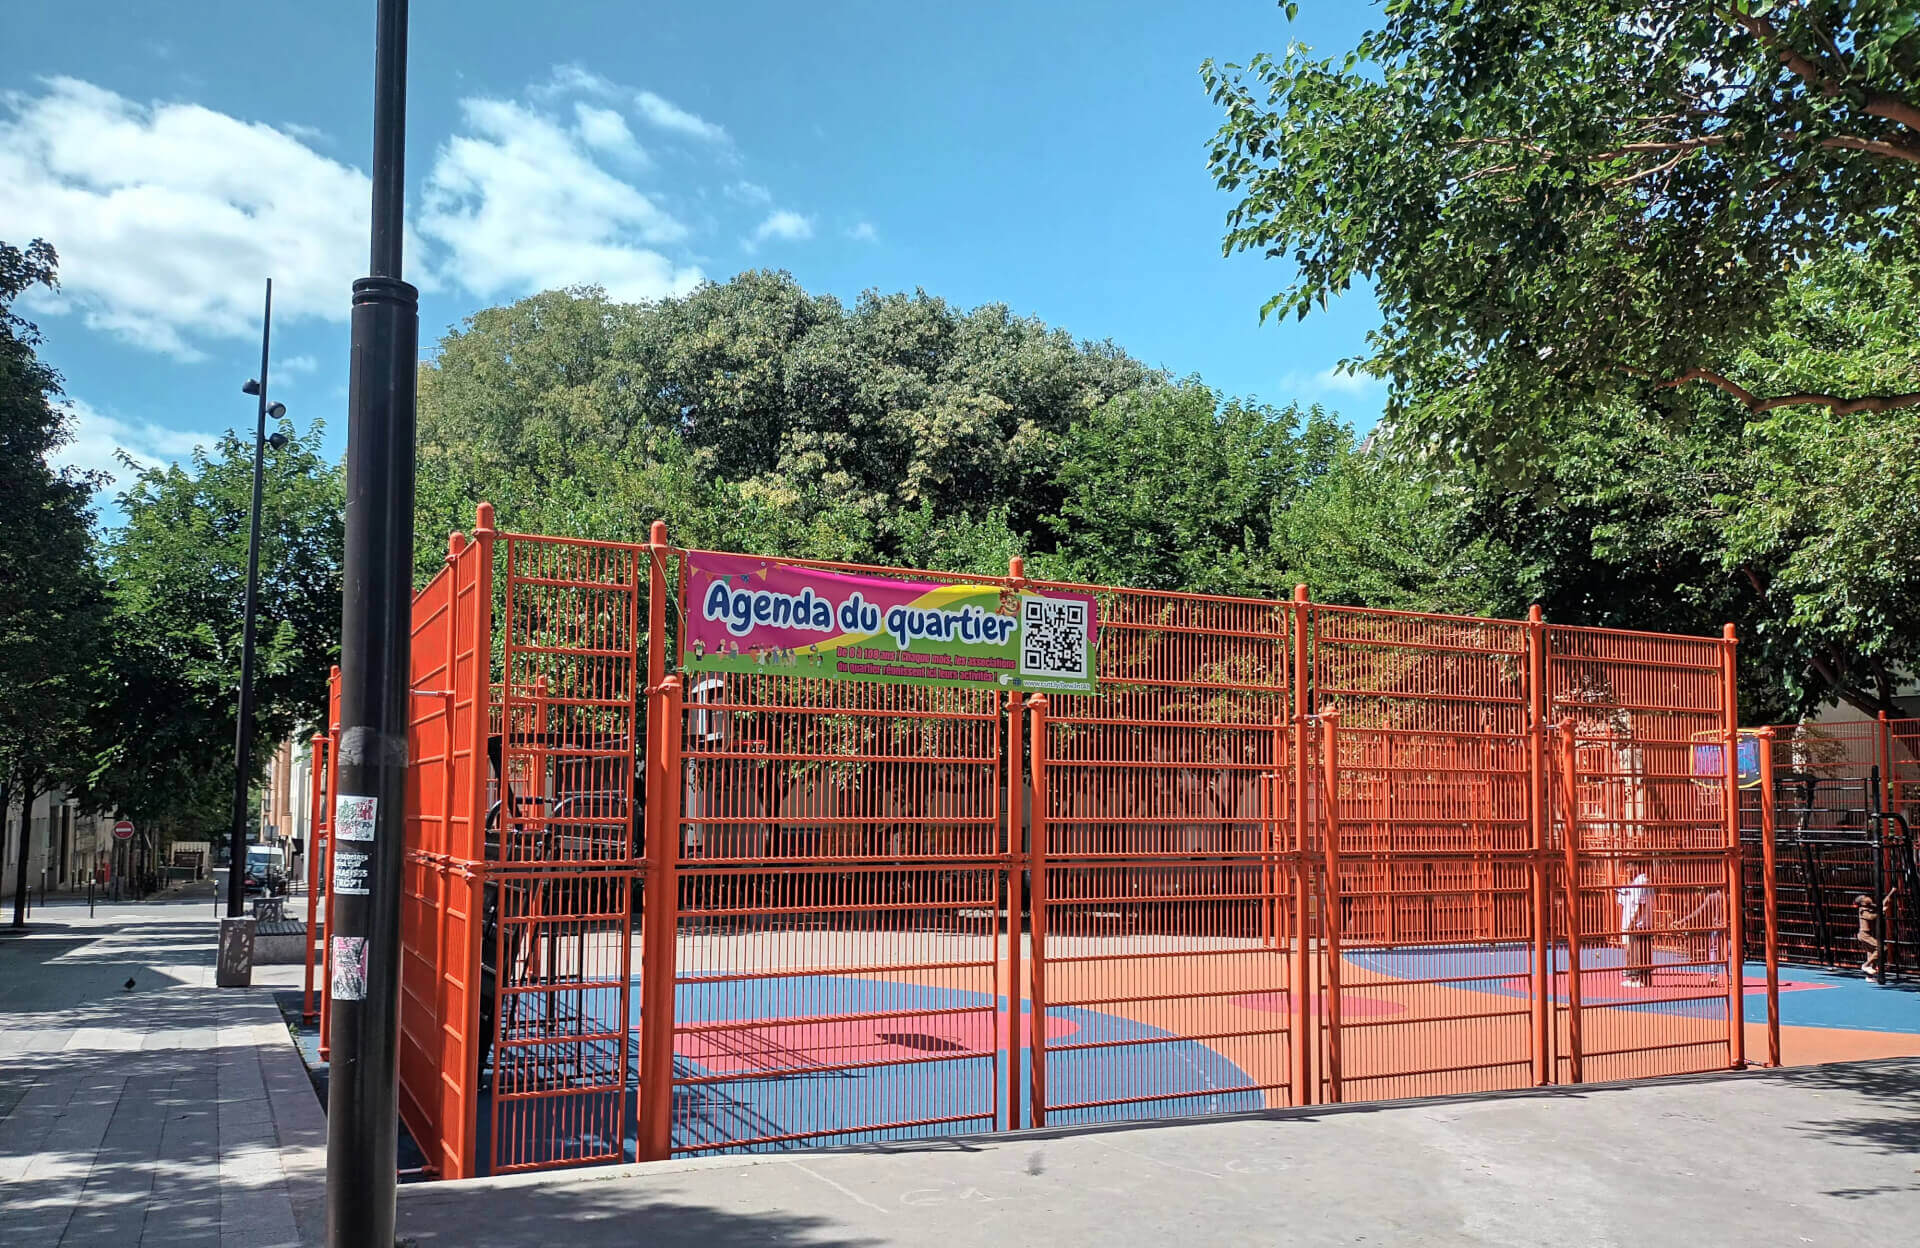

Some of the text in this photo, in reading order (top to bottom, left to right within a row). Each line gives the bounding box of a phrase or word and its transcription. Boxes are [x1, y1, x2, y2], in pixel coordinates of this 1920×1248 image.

[705, 582, 1015, 647] Agenda du quartier
[837, 646, 848, 657] De
[880, 650, 895, 661] ans
[901, 650, 930, 664] Chaque
[954, 654, 967, 666] les
[967, 656, 1016, 669] associations
[837, 661, 848, 672] du
[849, 662, 881, 674] quartier
[882, 663, 925, 677] réunissent
[938, 667, 958, 680] leurs
[959, 669, 994, 682] activités
